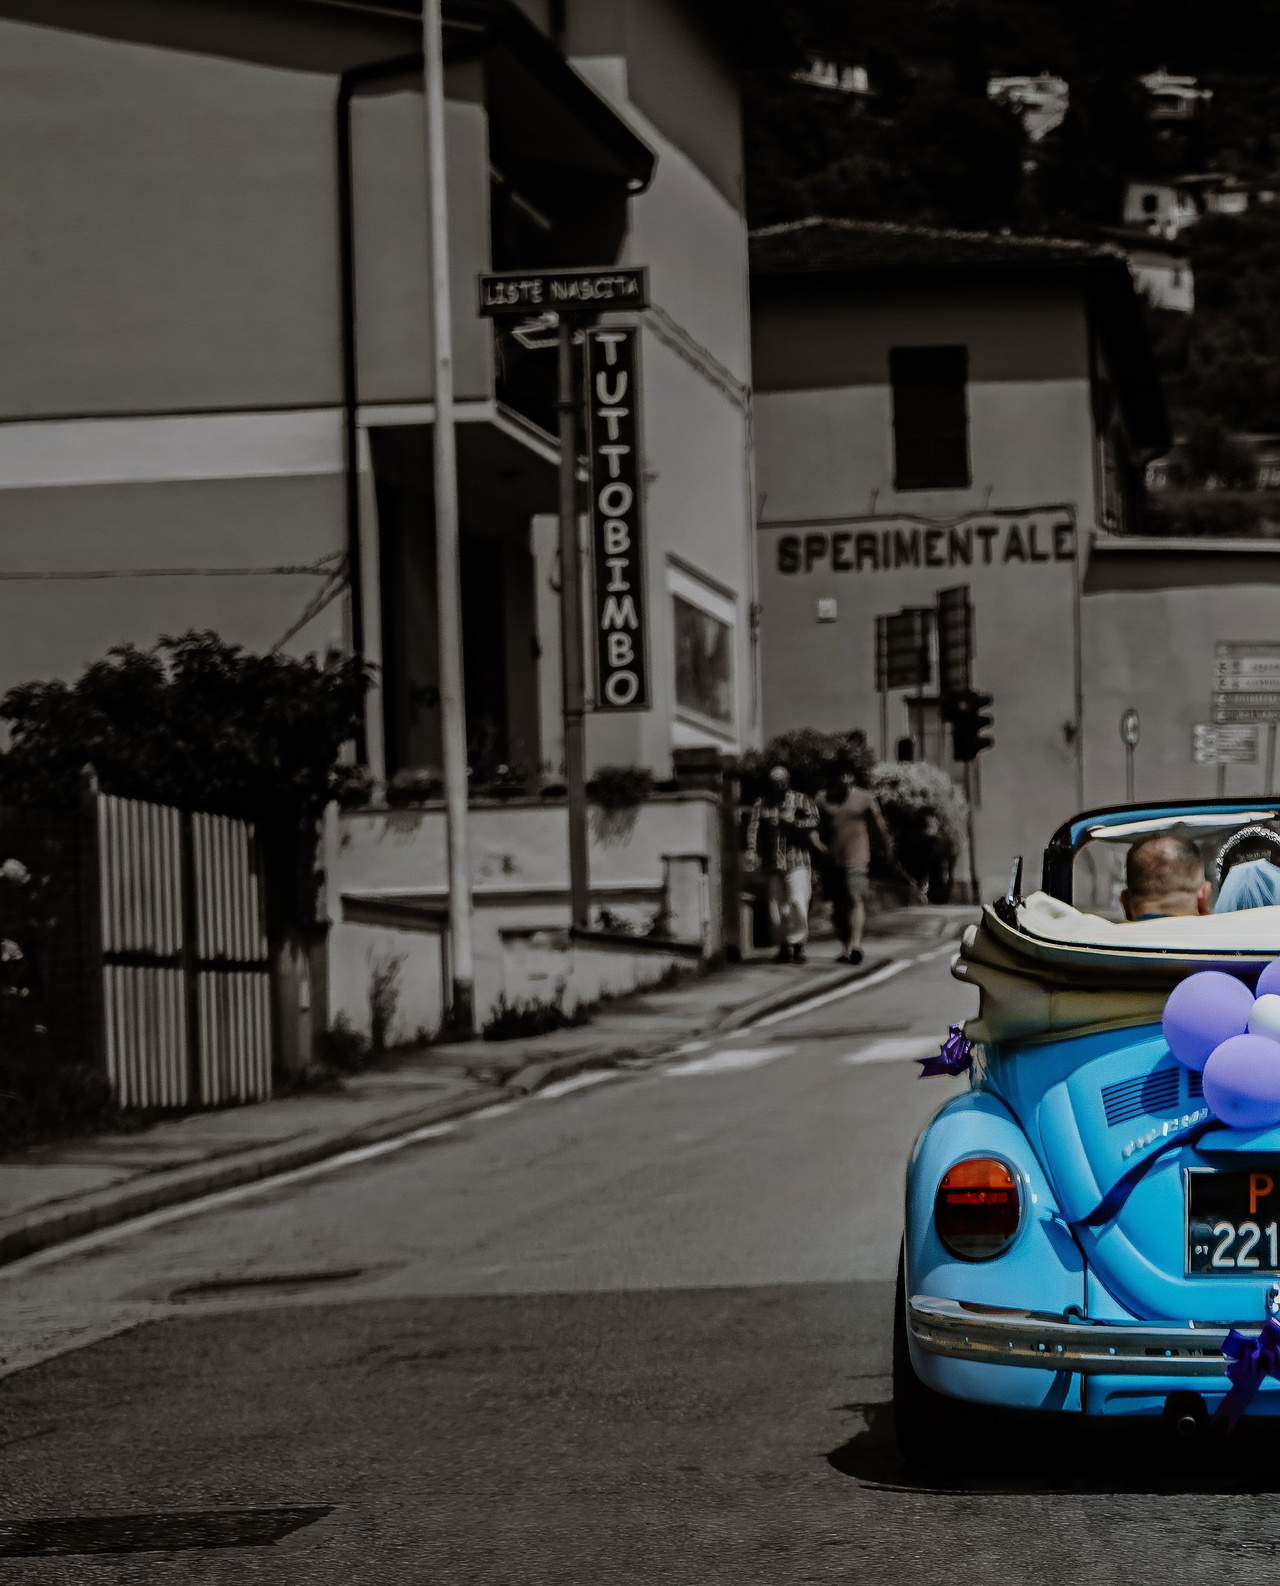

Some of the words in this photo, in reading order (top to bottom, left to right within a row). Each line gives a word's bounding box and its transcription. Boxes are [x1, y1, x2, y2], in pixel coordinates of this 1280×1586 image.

[487, 278, 544, 304] LISTE
[551, 274, 639, 301] NASCITA
[595, 333, 639, 705] TUTTOBIMBO
[777, 523, 1076, 574] SPERIMENTALE
